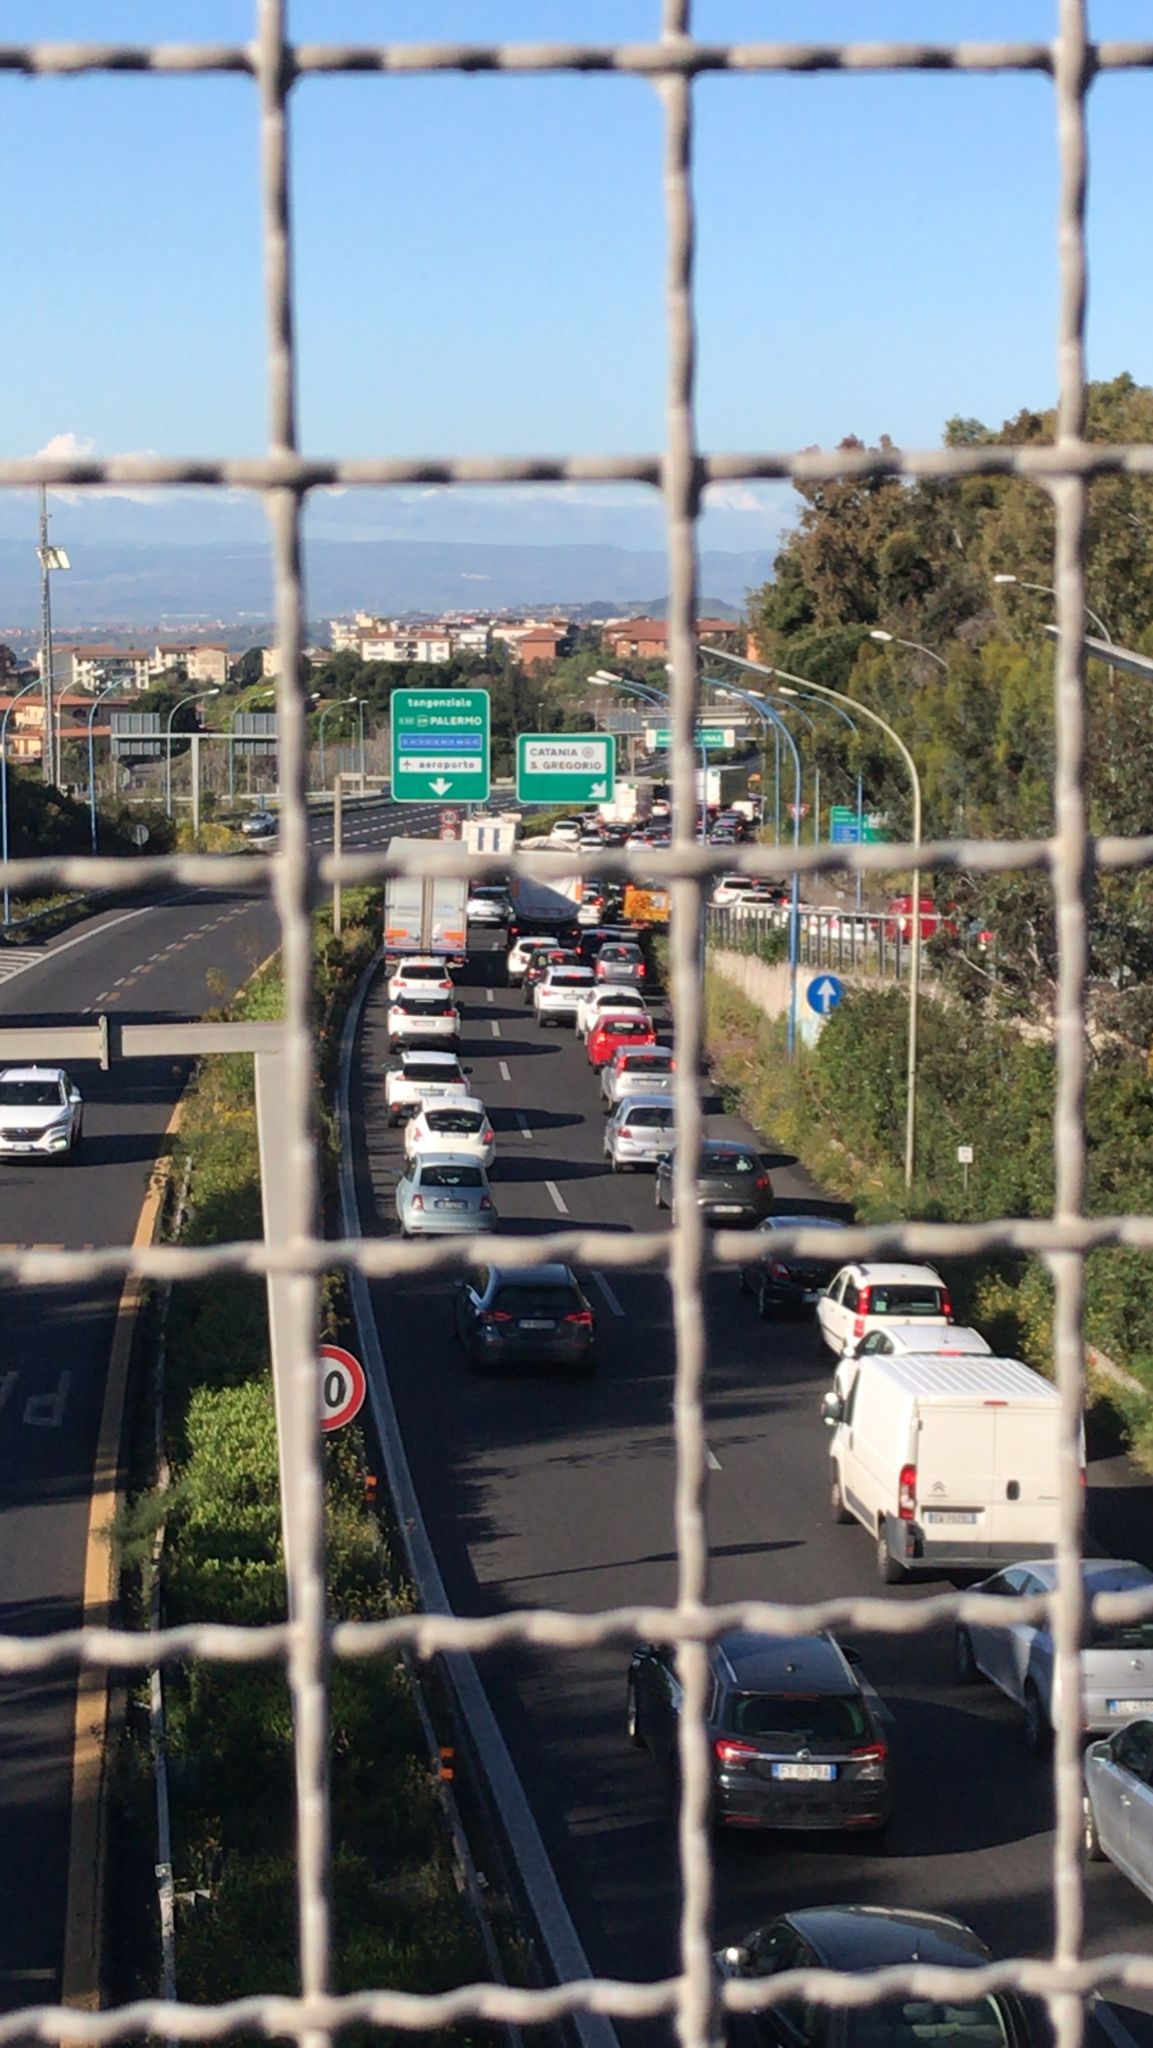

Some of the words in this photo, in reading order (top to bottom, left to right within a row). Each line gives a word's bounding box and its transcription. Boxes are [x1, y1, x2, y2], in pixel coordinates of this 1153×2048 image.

[408, 698, 472, 709] tangenziale
[430, 716, 482, 726] PALERMO
[530, 748, 578, 757] CATANIA
[419, 760, 475, 769] aeroporto
[530, 761, 541, 770] S.
[543, 761, 602, 770] GREGORIO
